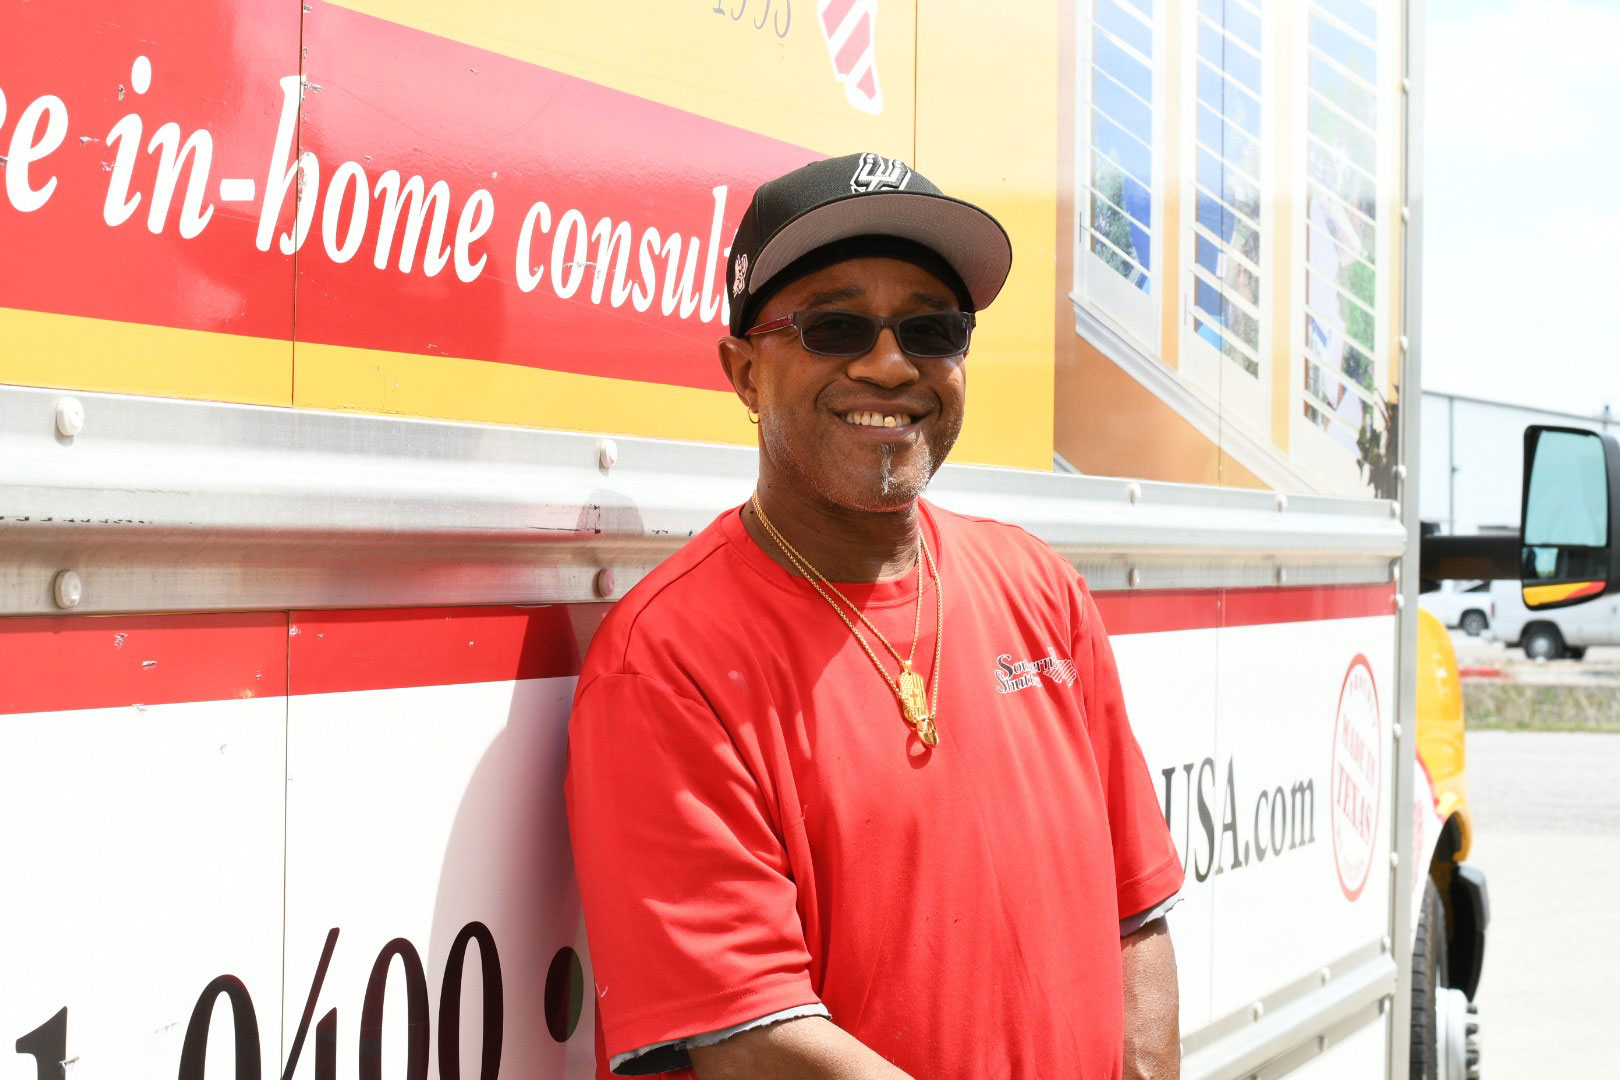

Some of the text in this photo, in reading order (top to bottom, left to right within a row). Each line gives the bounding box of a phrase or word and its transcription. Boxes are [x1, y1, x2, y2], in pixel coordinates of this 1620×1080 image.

[0, 87, 69, 213] e
[103, 55, 494, 284] in-home
[1161, 752, 1315, 883] USA.com
[1337, 761, 1372, 846] TEXAS
